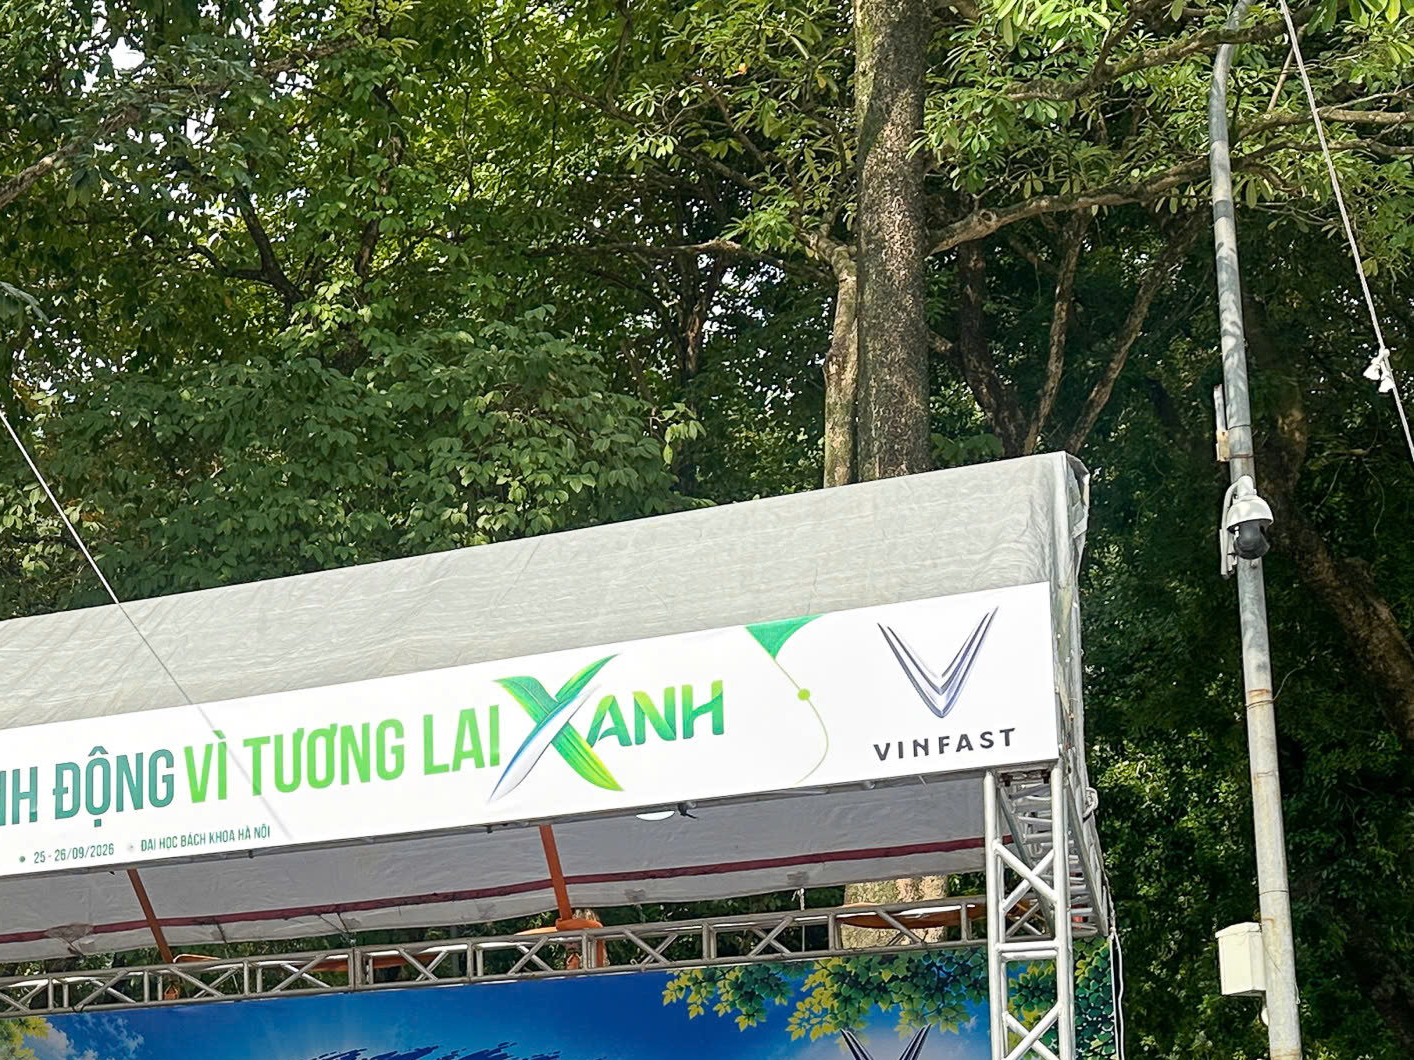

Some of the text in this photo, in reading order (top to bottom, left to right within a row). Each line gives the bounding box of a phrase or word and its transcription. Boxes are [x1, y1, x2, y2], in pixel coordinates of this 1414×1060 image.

[53, 745, 175, 828] ĐỘNG
[183, 730, 228, 804] VÌ
[243, 719, 405, 797] TƯƠNG
[423, 704, 500, 775] LAI
[488, 652, 724, 802] XANH
[873, 728, 1016, 761] VINFAST
[34, 851, 46, 864] 25
[54, 843, 115, 862] 26/09/2026
[181, 831, 206, 848] BÁCH
[209, 829, 235, 844] KHOA
[238, 825, 251, 841] HÀ
[254, 823, 271, 840] NỘI
